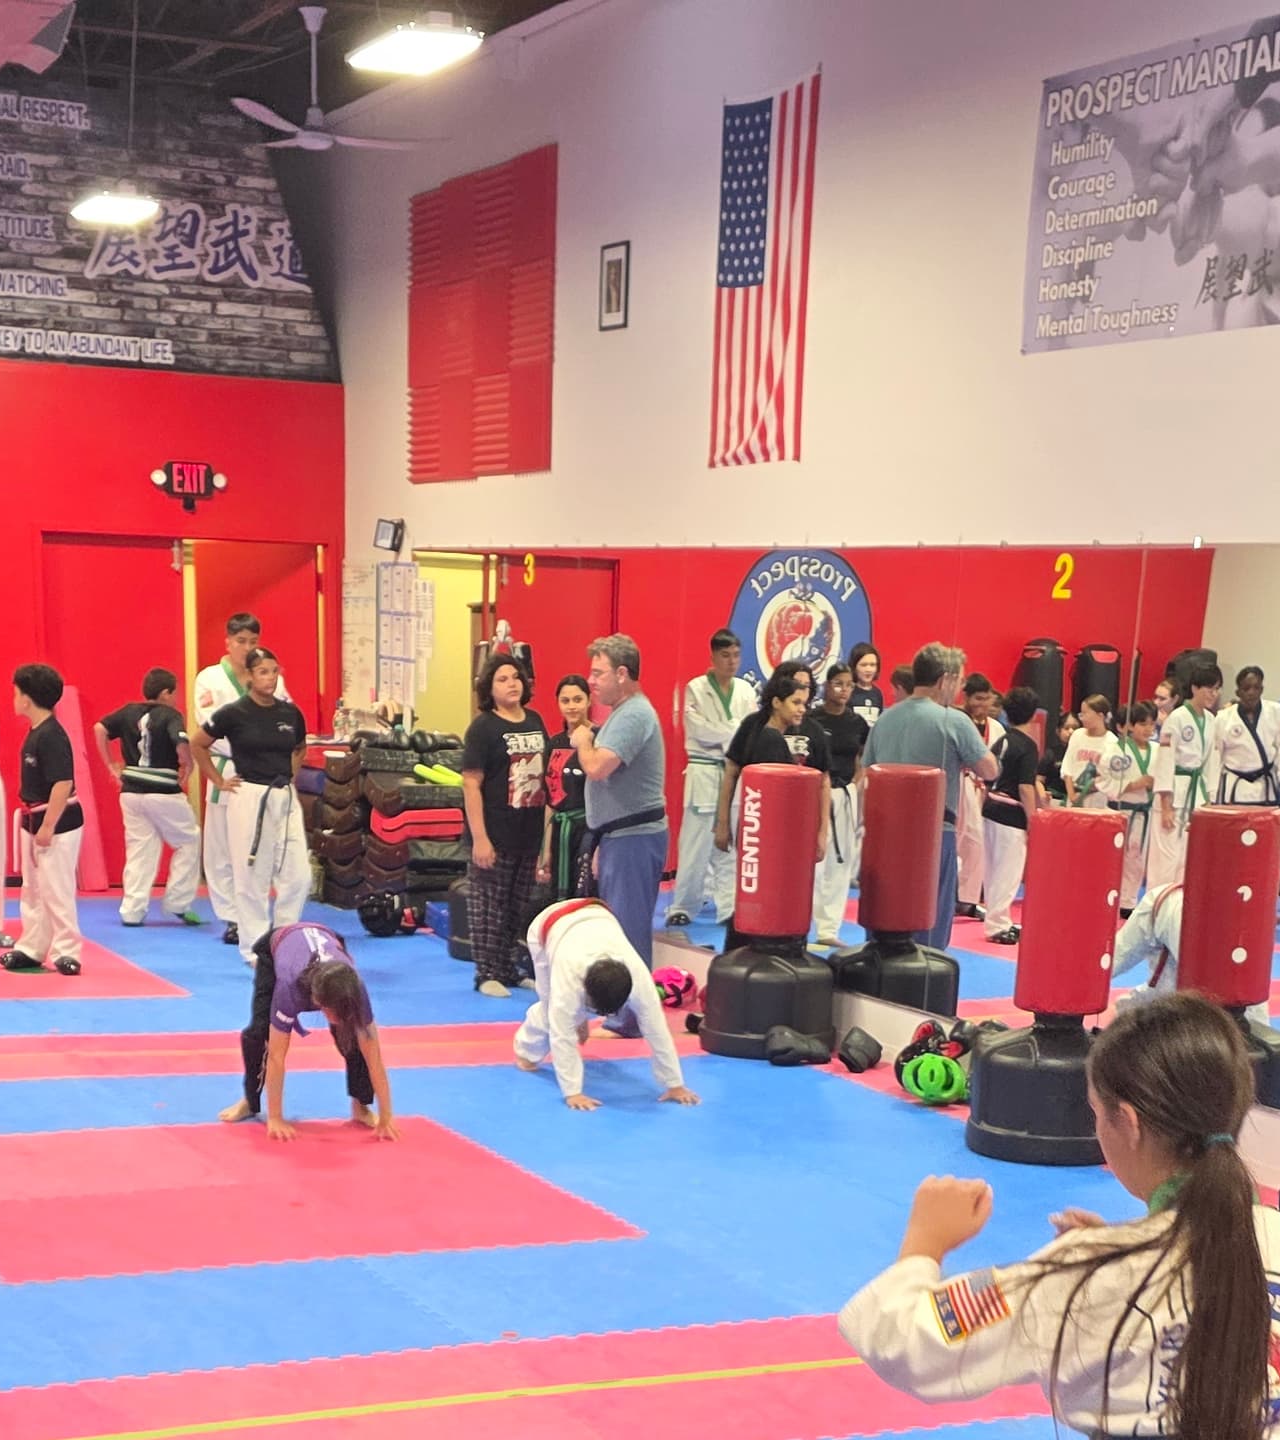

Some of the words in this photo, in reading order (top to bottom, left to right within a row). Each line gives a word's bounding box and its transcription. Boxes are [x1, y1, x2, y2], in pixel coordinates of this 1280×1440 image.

[1045, 62, 1167, 127] PROSPECT
[23, 98, 89, 127] RESPECT.
[1051, 130, 1114, 167] Humility
[1047, 170, 1115, 200] Courage
[1044, 194, 1158, 234] Determination
[1042, 239, 1113, 270] Discipline
[1039, 275, 1099, 303] Honesty
[1035, 307, 1088, 340] Mental
[1091, 303, 1179, 336] Toughness
[24, 331, 42, 351] TO
[47, 334, 68, 352] AN
[70, 335, 140, 359] ABUNDANT
[142, 341, 174, 361] LIFE.
[172, 463, 208, 494] EXIT
[523, 552, 534, 586] 3
[1052, 552, 1073, 599] 2
[741, 786, 762, 894] CENTURY
